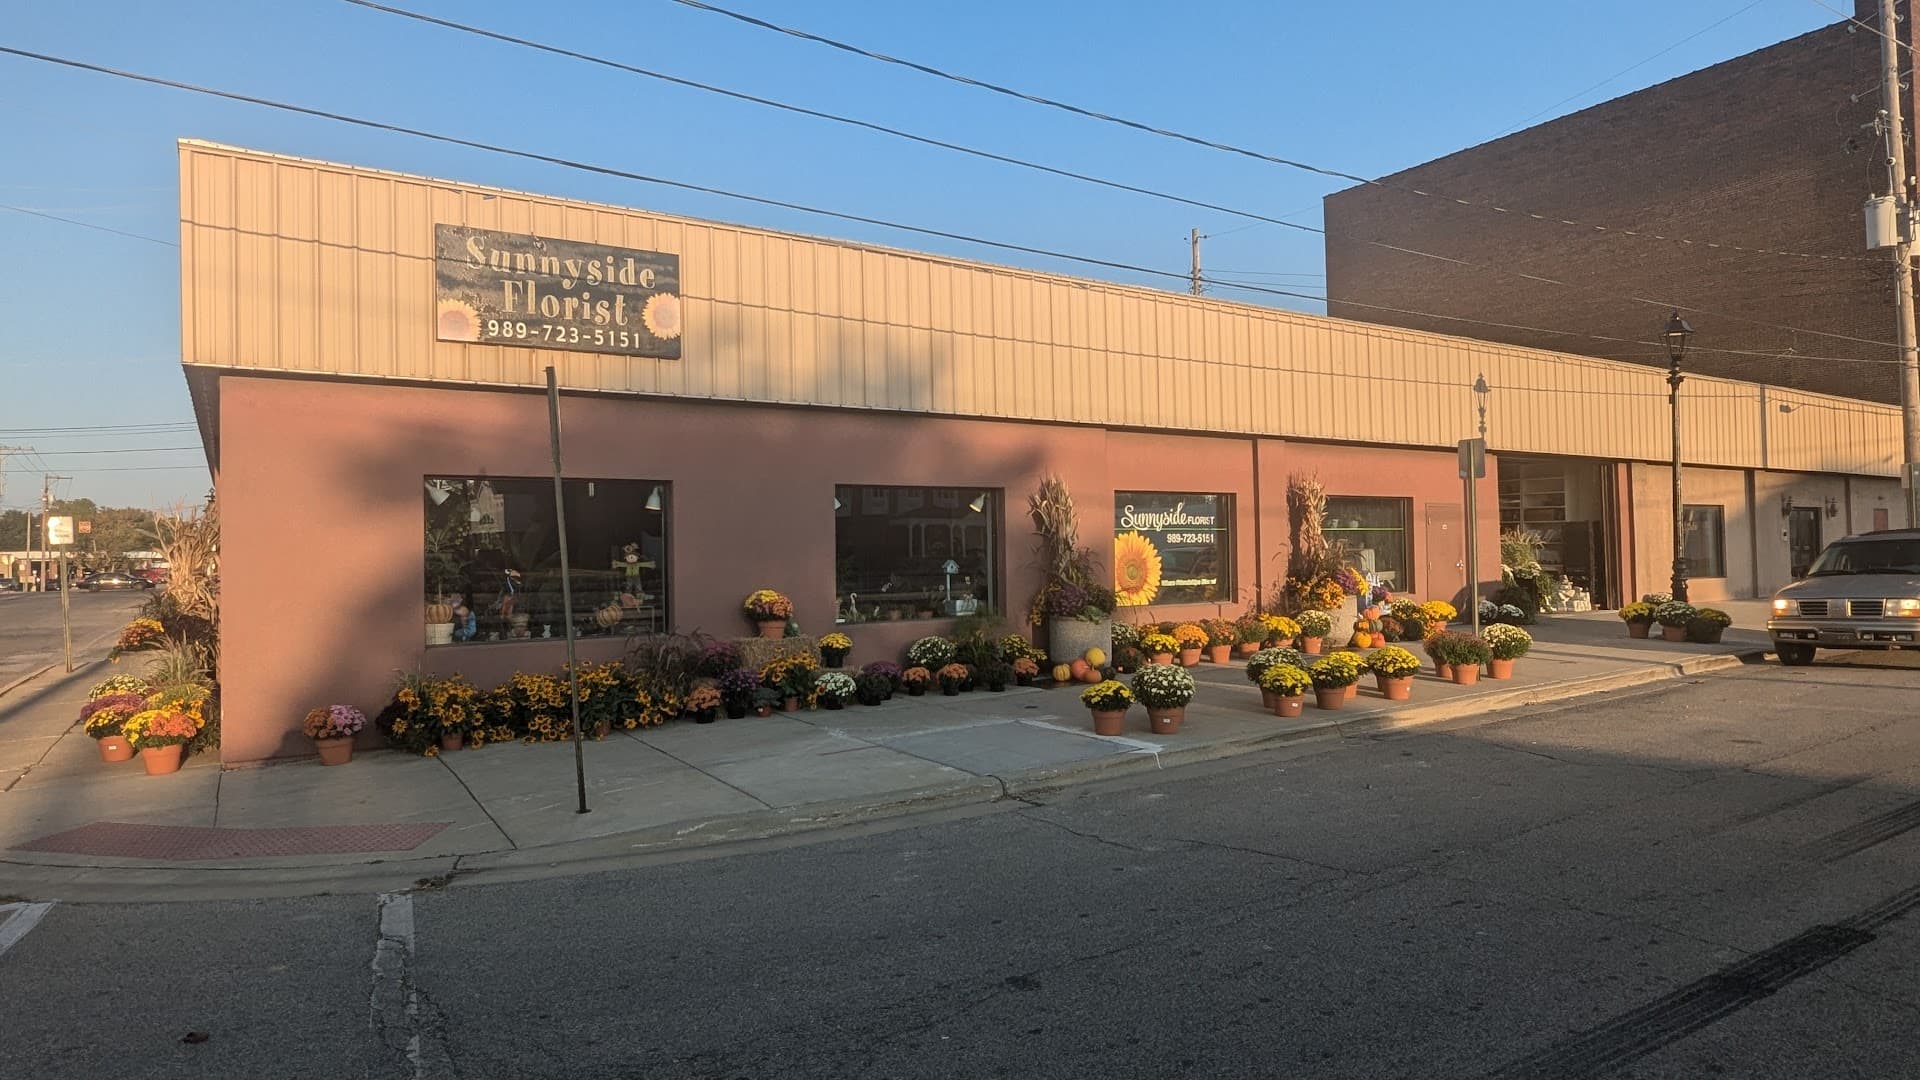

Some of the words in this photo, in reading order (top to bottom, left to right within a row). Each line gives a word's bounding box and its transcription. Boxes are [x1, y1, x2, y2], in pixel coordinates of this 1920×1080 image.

[466, 236, 656, 290] Sunnyside
[500, 279, 629, 327] Florist
[488, 320, 640, 349] 989-723-5151
[1120, 502, 1188, 532] Sunnyside
[1187, 516, 1215, 525] FLORIST
[1166, 533, 1214, 544] 989-723-5151
